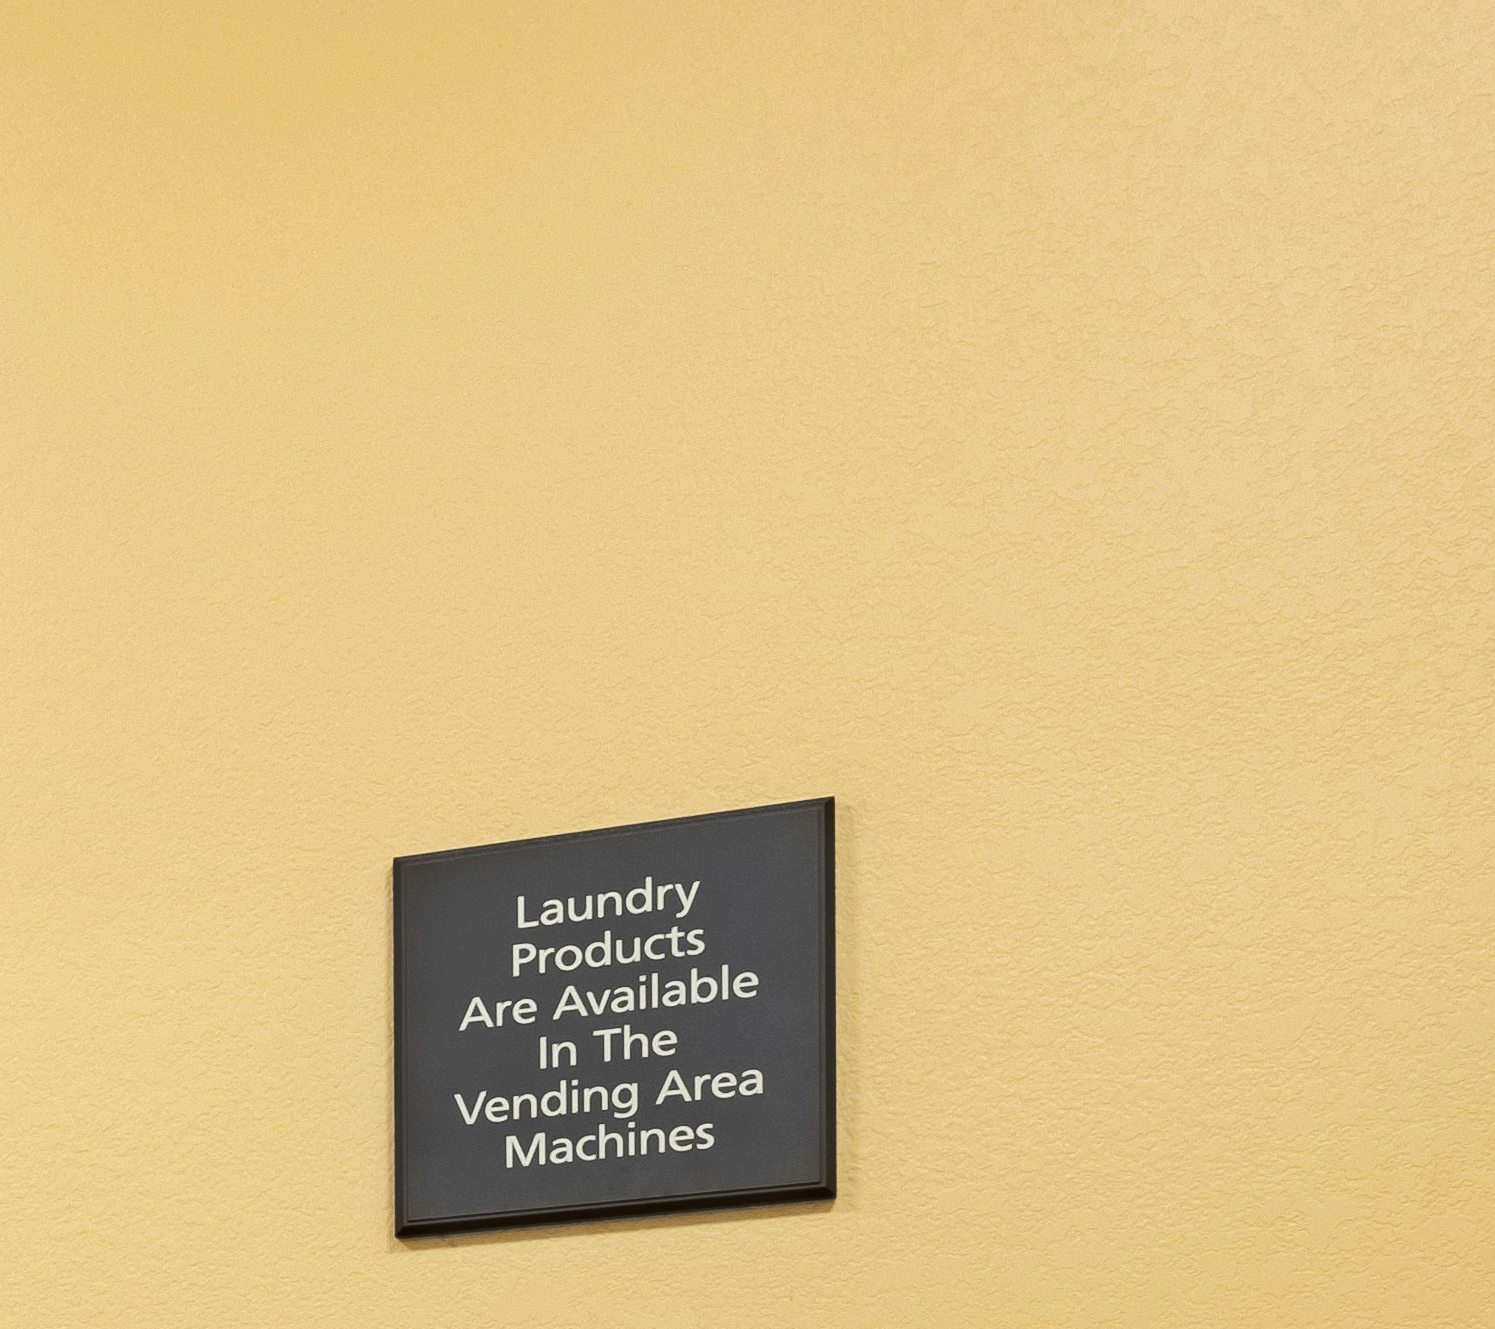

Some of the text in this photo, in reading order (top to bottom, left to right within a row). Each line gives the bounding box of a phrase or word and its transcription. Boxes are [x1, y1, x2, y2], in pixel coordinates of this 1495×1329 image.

[517, 876, 700, 928] Laundry
[512, 926, 705, 977] Products
[459, 964, 760, 1031] Are Available
[539, 1025, 678, 1069] In The
[454, 1068, 764, 1126] Vending Area
[505, 1122, 715, 1168] Machines
